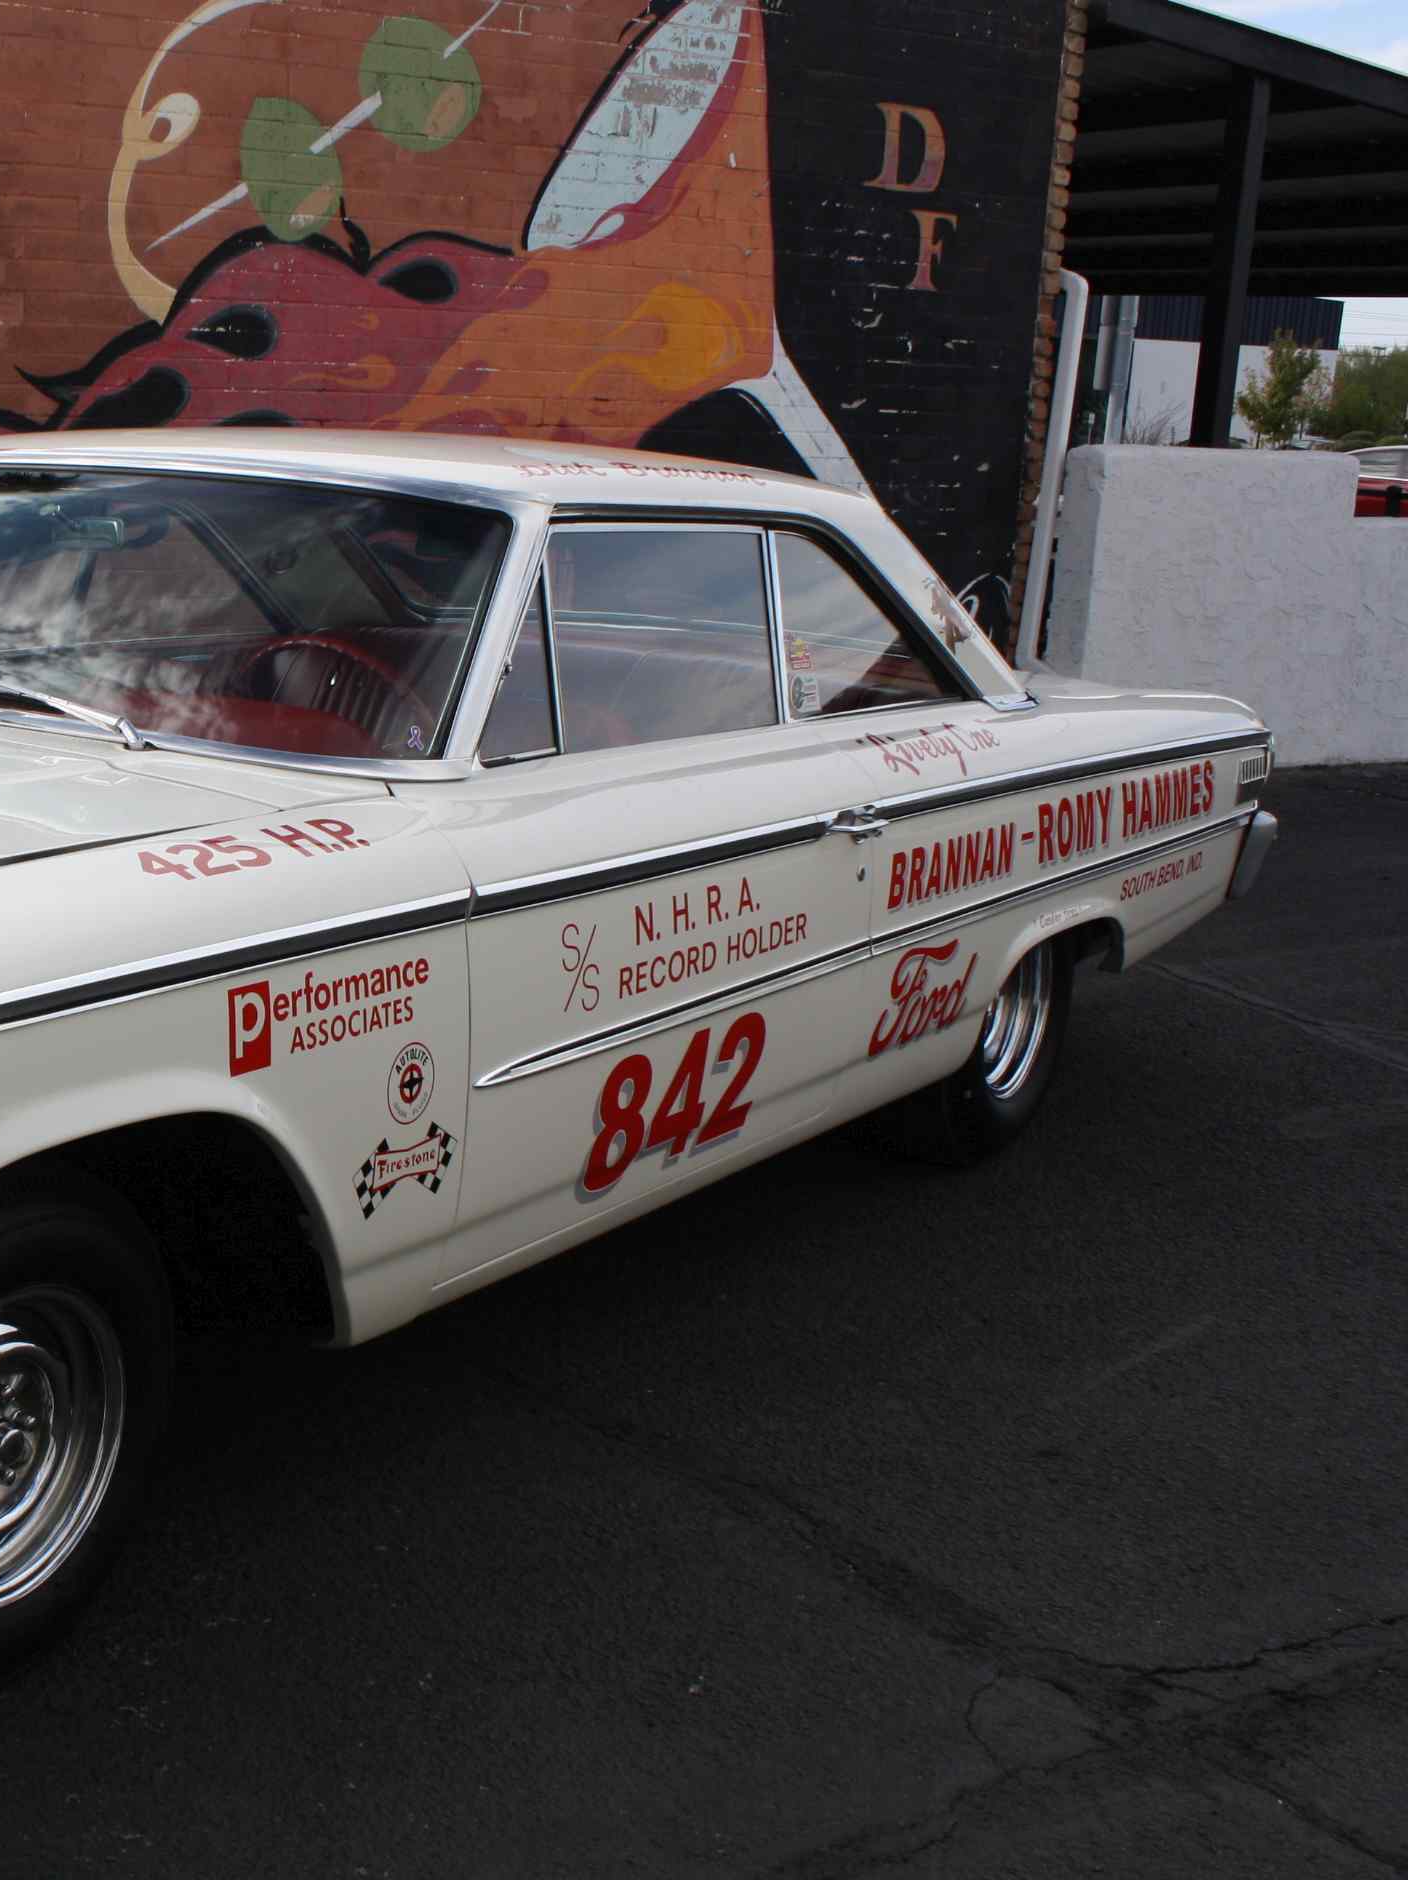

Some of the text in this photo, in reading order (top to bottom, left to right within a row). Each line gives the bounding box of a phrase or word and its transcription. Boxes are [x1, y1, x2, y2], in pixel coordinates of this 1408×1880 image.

[863, 102, 946, 193] D
[906, 209, 958, 292] F
[1121, 760, 1216, 840] HAMMES
[137, 818, 372, 881] 425 H.P.
[1120, 868, 1157, 901] SOUTH
[619, 912, 808, 1000] RECORD HOLDER
[290, 996, 414, 1055] ASSOCIATES
[867, 938, 979, 1058] Ford
[394, 1047, 430, 1075] AUTOLITE
[577, 1011, 767, 1198] 842
[377, 1149, 436, 1180] Firestone
